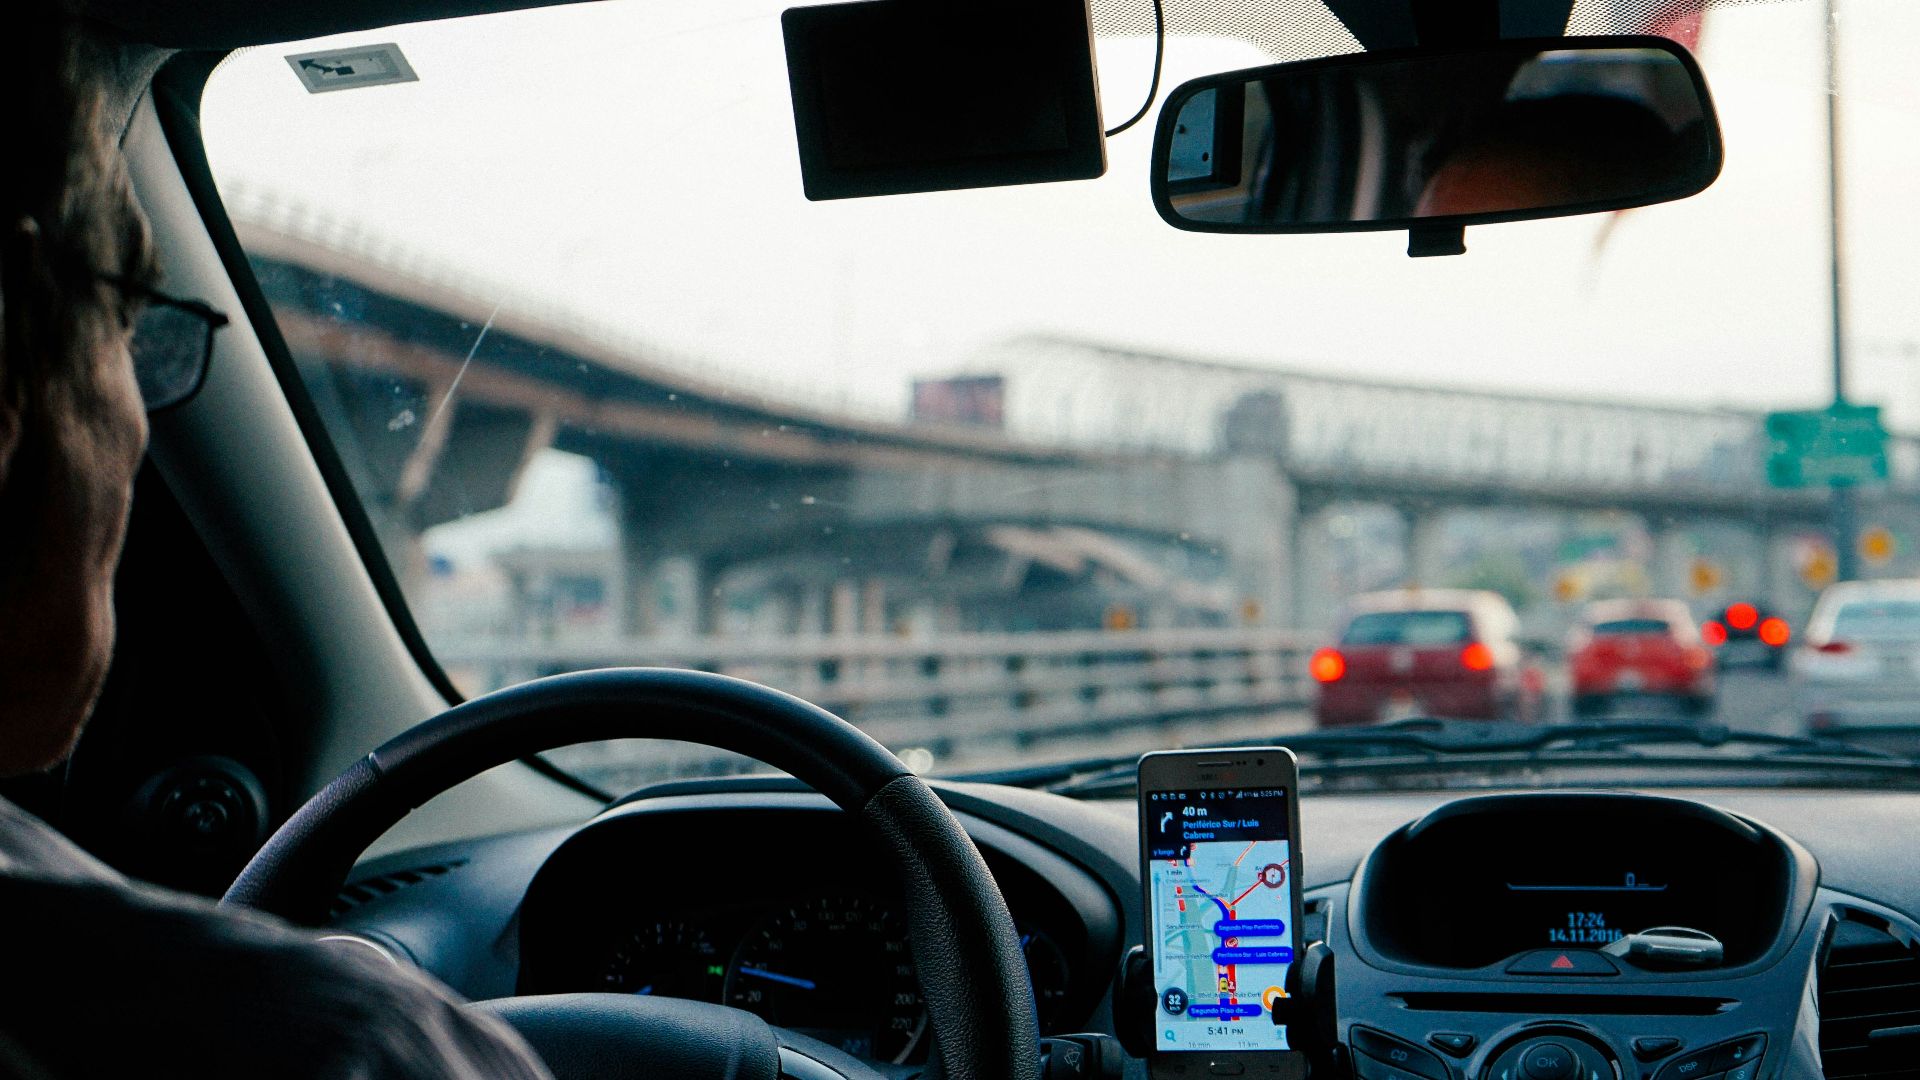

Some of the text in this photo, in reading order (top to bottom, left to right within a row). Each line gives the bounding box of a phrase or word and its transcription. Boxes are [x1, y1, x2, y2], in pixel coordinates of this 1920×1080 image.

[1273, 789, 1283, 797] PM
[1182, 806, 1208, 817] 40 m
[1183, 820, 1221, 830] Periférico
[1222, 820, 1236, 828] Sur
[1242, 819, 1259, 828] Luis
[1183, 831, 1215, 840] Cabrera
[1567, 911, 1605, 928] 17:24
[1548, 928, 1624, 943] 14.11.2016
[1168, 994, 1181, 1005] 32
[1208, 1026, 1228, 1036] 5:41
[1390, 1048, 1408, 1062] CD
[1536, 1057, 1560, 1069] OK
[1678, 1061, 1699, 1073] DSP
[1736, 1070, 1745, 1080] 3
